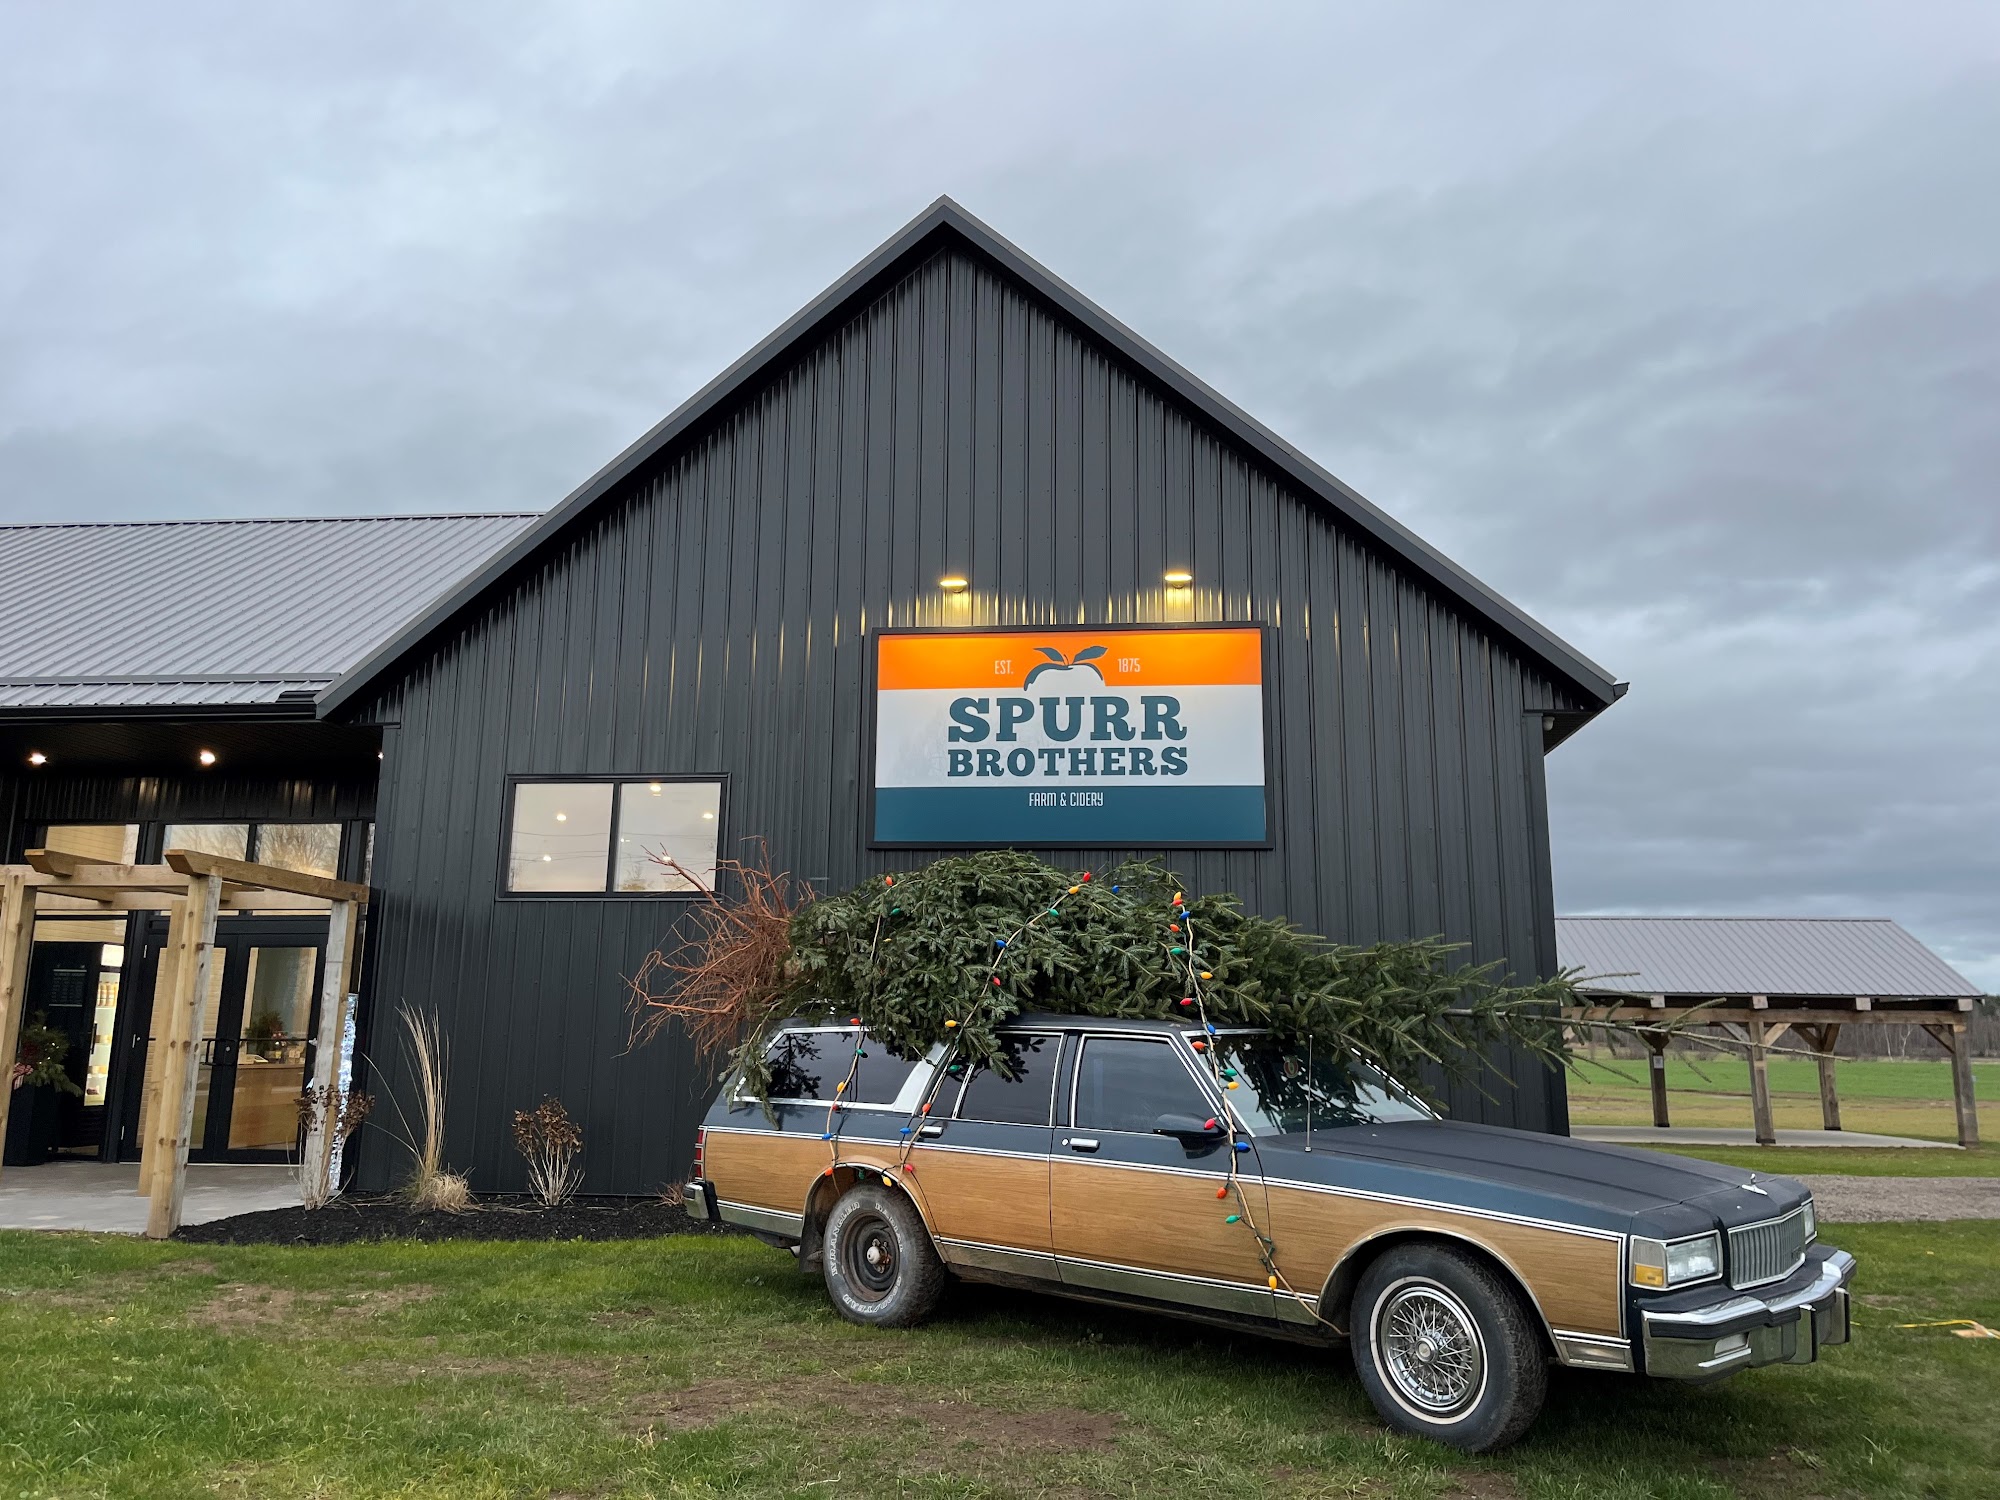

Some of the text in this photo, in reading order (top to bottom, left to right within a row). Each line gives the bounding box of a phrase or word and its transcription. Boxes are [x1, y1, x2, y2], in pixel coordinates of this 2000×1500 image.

[994, 658, 1141, 675] EST. 1875
[948, 696, 1187, 742] SPURR
[947, 746, 1188, 777] BROTHERS
[1029, 792, 1104, 807] FARM & CIDERY
[830, 1202, 860, 1276] WRANGLER
[843, 1276, 902, 1313] GOODYEAR
